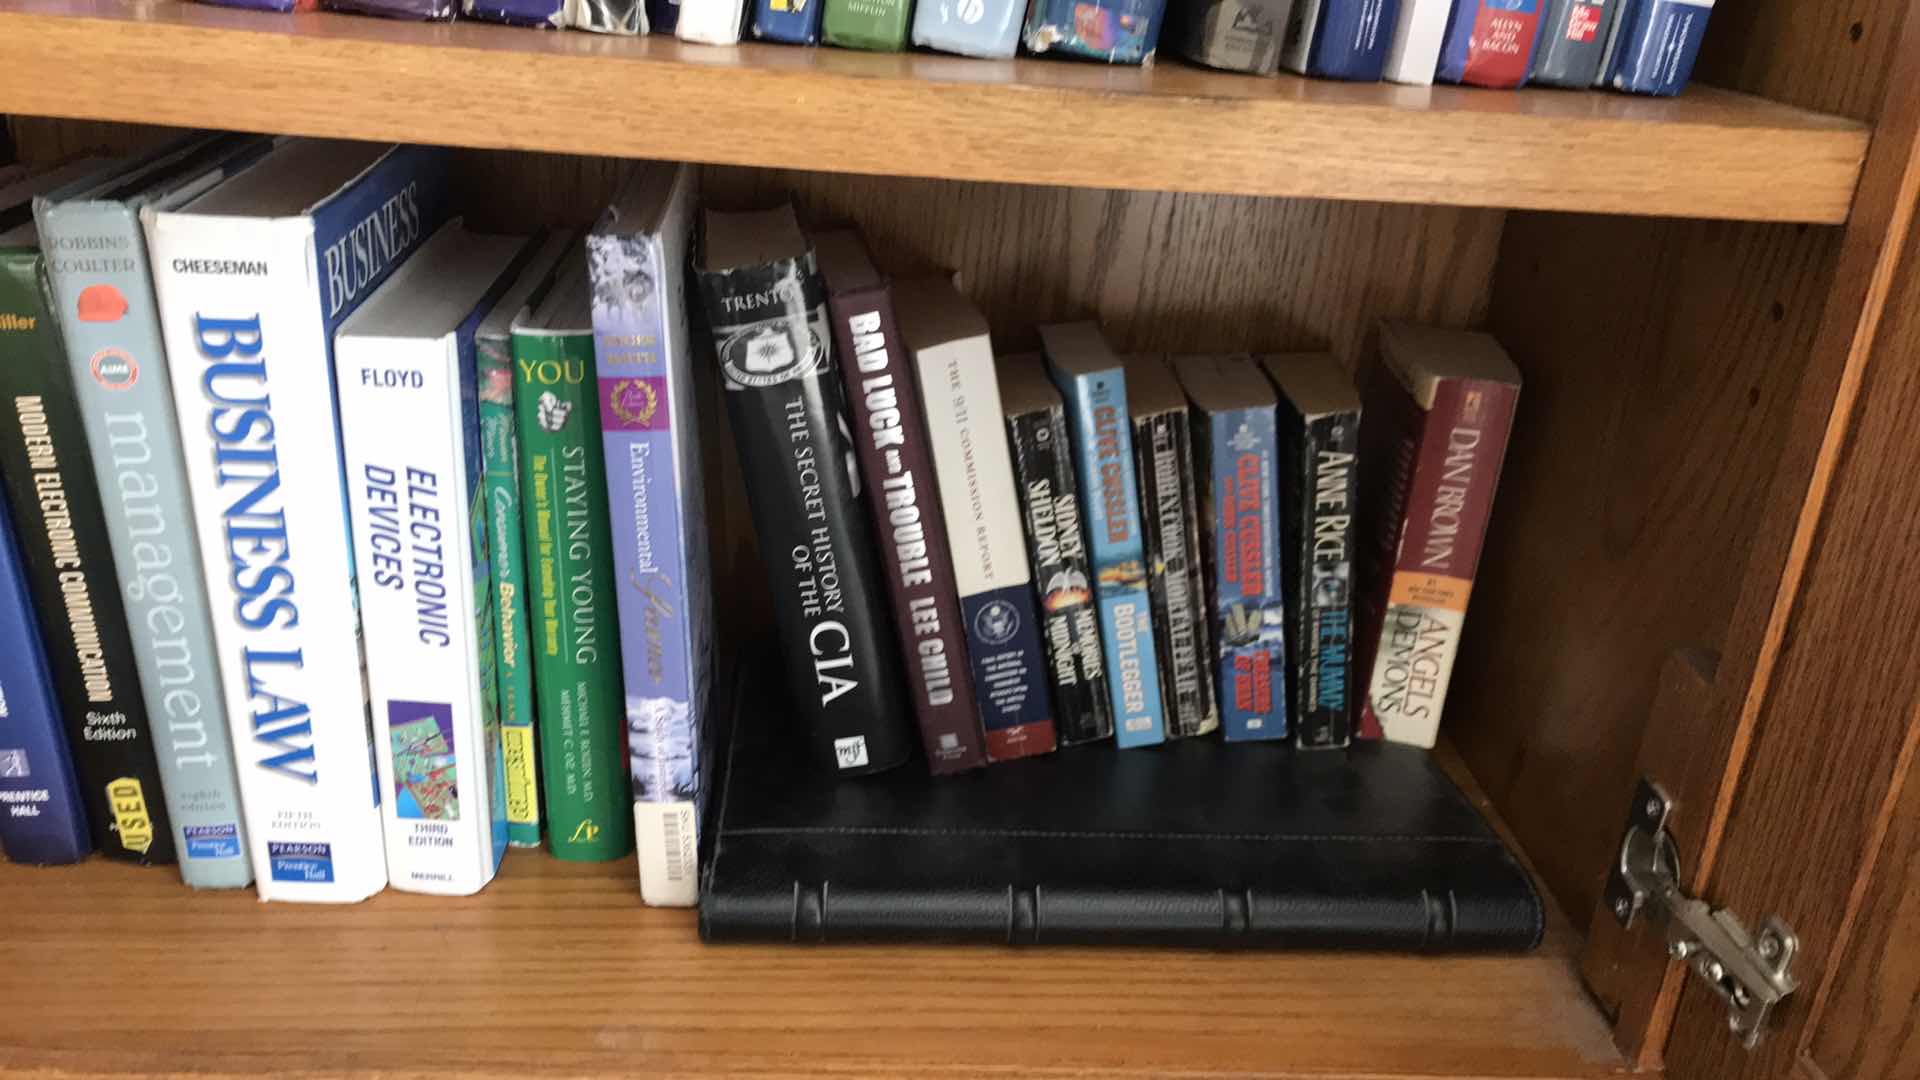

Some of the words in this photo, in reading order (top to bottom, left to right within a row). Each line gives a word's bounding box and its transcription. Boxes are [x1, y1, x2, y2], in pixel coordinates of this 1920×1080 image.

[1481, 38, 1520, 56] BACON
[1489, 16, 1523, 32] ALLYN
[46, 236, 130, 250] ROBBINS
[49, 256, 137, 274] COULTER
[172, 258, 269, 277] CHEESEMAN
[323, 180, 421, 319] BUSINESS
[0, 312, 37, 331] iller
[848, 310, 889, 374] BAD
[360, 367, 424, 390] FLOYD
[518, 358, 586, 385] YOU
[15, 395, 57, 469] MODERN
[785, 395, 811, 443] THE
[862, 373, 905, 451] LUCK
[1093, 405, 1121, 460] CLIVE
[194, 311, 300, 632] BUSINESS
[794, 446, 828, 522] SECRET
[947, 359, 962, 391] THE
[959, 427, 985, 522] COMMISSION
[976, 526, 995, 581] REPORT
[1315, 450, 1355, 512] ANNE
[1441, 426, 1481, 484] DAN
[34, 472, 82, 569] ELECTRONIC
[363, 463, 405, 592] DEVICES
[561, 446, 592, 561] STAYING
[629, 440, 659, 575] Environmental
[882, 470, 933, 588] TROUBLE
[1028, 478, 1063, 568] SHELDON
[1054, 492, 1084, 559] SIDNEY
[1420, 485, 1467, 569] BROWN
[405, 465, 451, 648] ELECTRONIC
[791, 544, 814, 572] OF
[811, 526, 845, 614] HISTORY
[1313, 514, 1351, 562] RICE
[104, 411, 218, 769] management
[571, 568, 598, 665] YOUNG
[798, 575, 822, 618] THE
[909, 596, 941, 637] LEE
[58, 571, 113, 703] COMMUNICATION
[499, 581, 517, 668] Behavior
[1048, 615, 1078, 687] MIDNIGHT
[808, 619, 859, 709] CIA
[917, 637, 954, 707] CHILD
[1113, 603, 1146, 714] BOOTLEGGER
[1376, 608, 1423, 714] DEMONS
[1402, 613, 1449, 720] ANGELS
[83, 726, 137, 742] Edition
[85, 711, 127, 727] Sixth
[241, 645, 319, 785] LAW
[10, 803, 41, 817] HALL
[112, 785, 151, 849] USED
[186, 824, 236, 836] PEARSON
[407, 835, 454, 848] EDITION
[414, 823, 449, 835] THIRD
[271, 843, 327, 855] PEARSON
[303, 866, 327, 880] Hall
